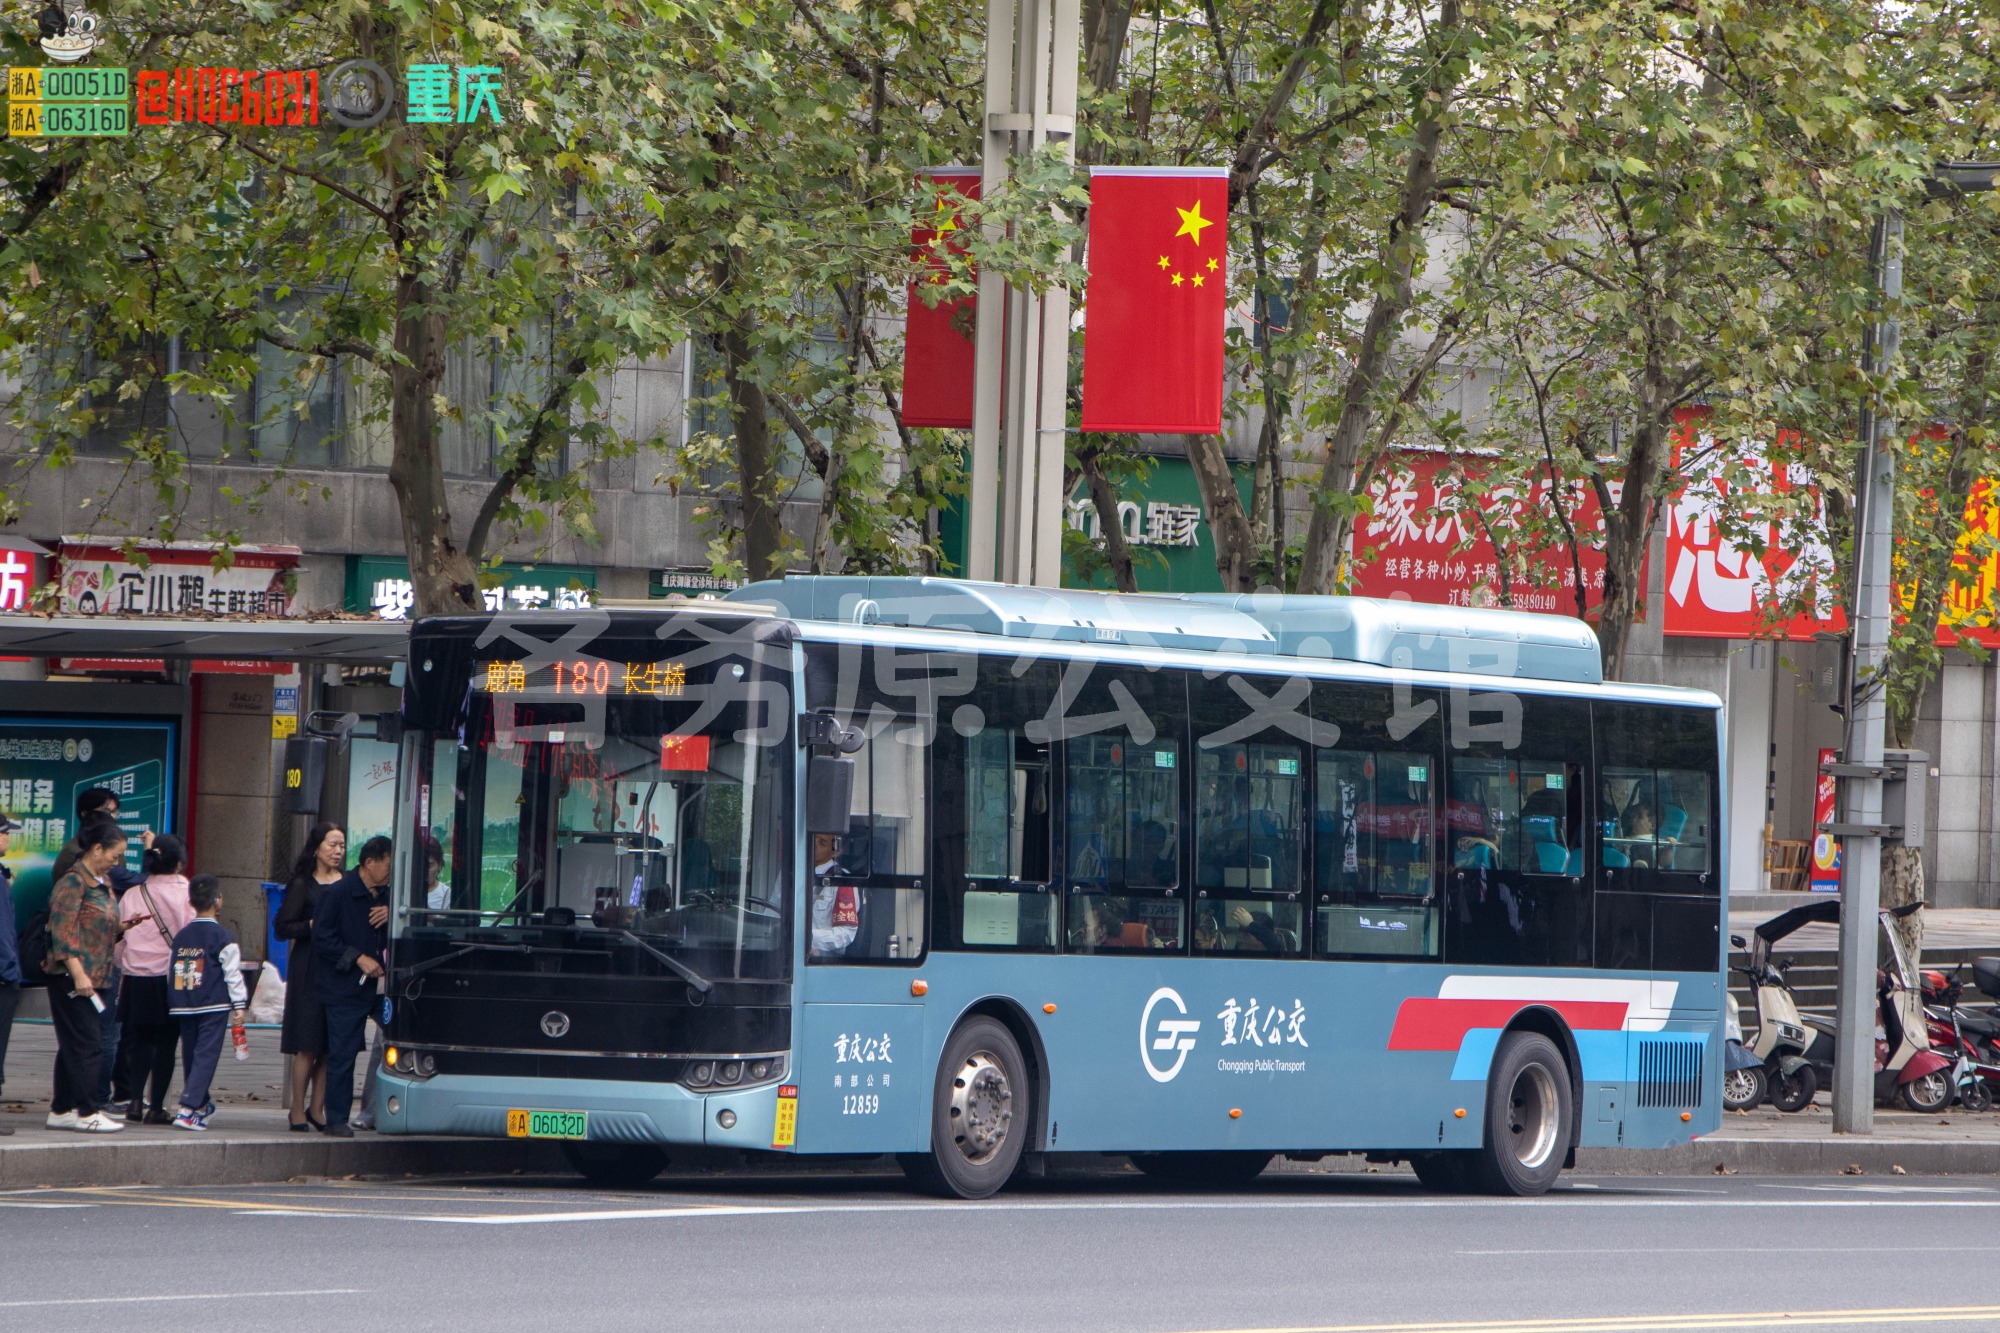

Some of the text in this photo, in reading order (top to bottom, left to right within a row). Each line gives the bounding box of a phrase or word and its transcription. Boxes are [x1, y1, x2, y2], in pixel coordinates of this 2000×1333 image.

[1148, 501, 1200, 546] 鞋家
[484, 660, 686, 696] 鹿角 180 长生桥
[286, 768, 301, 788] 180
[8, 818, 66, 852] 健康
[1217, 998, 1309, 1047] 重庆公交
[833, 1033, 893, 1063] 重庆公交
[834, 1074, 890, 1087] 南部公司
[1217, 1059, 1306, 1074] Chongqing Public Transport
[843, 1095, 879, 1115] 12859
